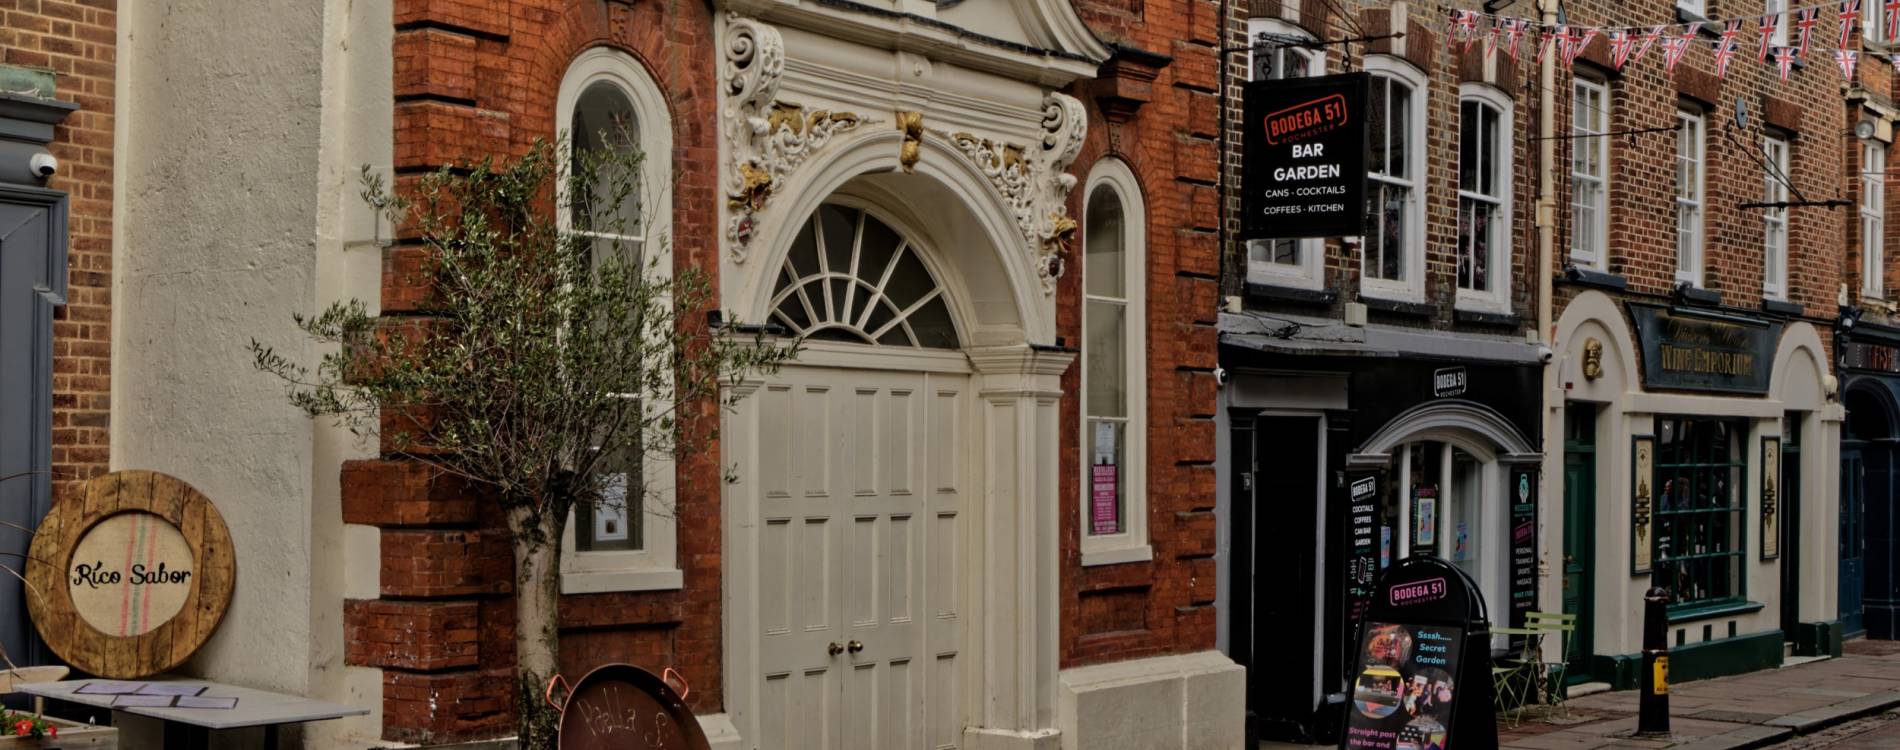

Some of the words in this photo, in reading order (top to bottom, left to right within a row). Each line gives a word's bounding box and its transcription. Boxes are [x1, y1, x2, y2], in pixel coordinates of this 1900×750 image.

[1270, 108, 1321, 137] BODEGA
[1325, 101, 1341, 120] 51
[1282, 123, 1335, 144] ROCHESTER
[1292, 143, 1324, 158] BAR
[1273, 164, 1340, 181] GARDEN
[1265, 188, 1289, 198] CANS
[1296, 185, 1346, 197] COCKTAILS
[1263, 205, 1302, 215] COFFEES
[1308, 203, 1345, 213] KITCHEN
[1661, 344, 1692, 371] WINE
[1694, 347, 1753, 376] EMPORIUM
[1436, 373, 1457, 390] BODEGA
[1457, 372, 1464, 386] 51
[1352, 504, 1374, 513] COCKTAILS
[1354, 515, 1372, 525] COFFEES
[1354, 538, 1372, 547] GARDEN
[130, 562, 191, 585] Sabor
[1393, 586, 1429, 601] BODEGA
[1431, 582, 1443, 594] 51
[1419, 643, 1446, 653] Secret
[1416, 654, 1446, 665] Garden
[1348, 726, 1379, 738] Straight
[1379, 731, 1397, 739] past
[1350, 738, 1361, 746] the
[1362, 739, 1375, 747] bar
[1376, 741, 1390, 749] and
